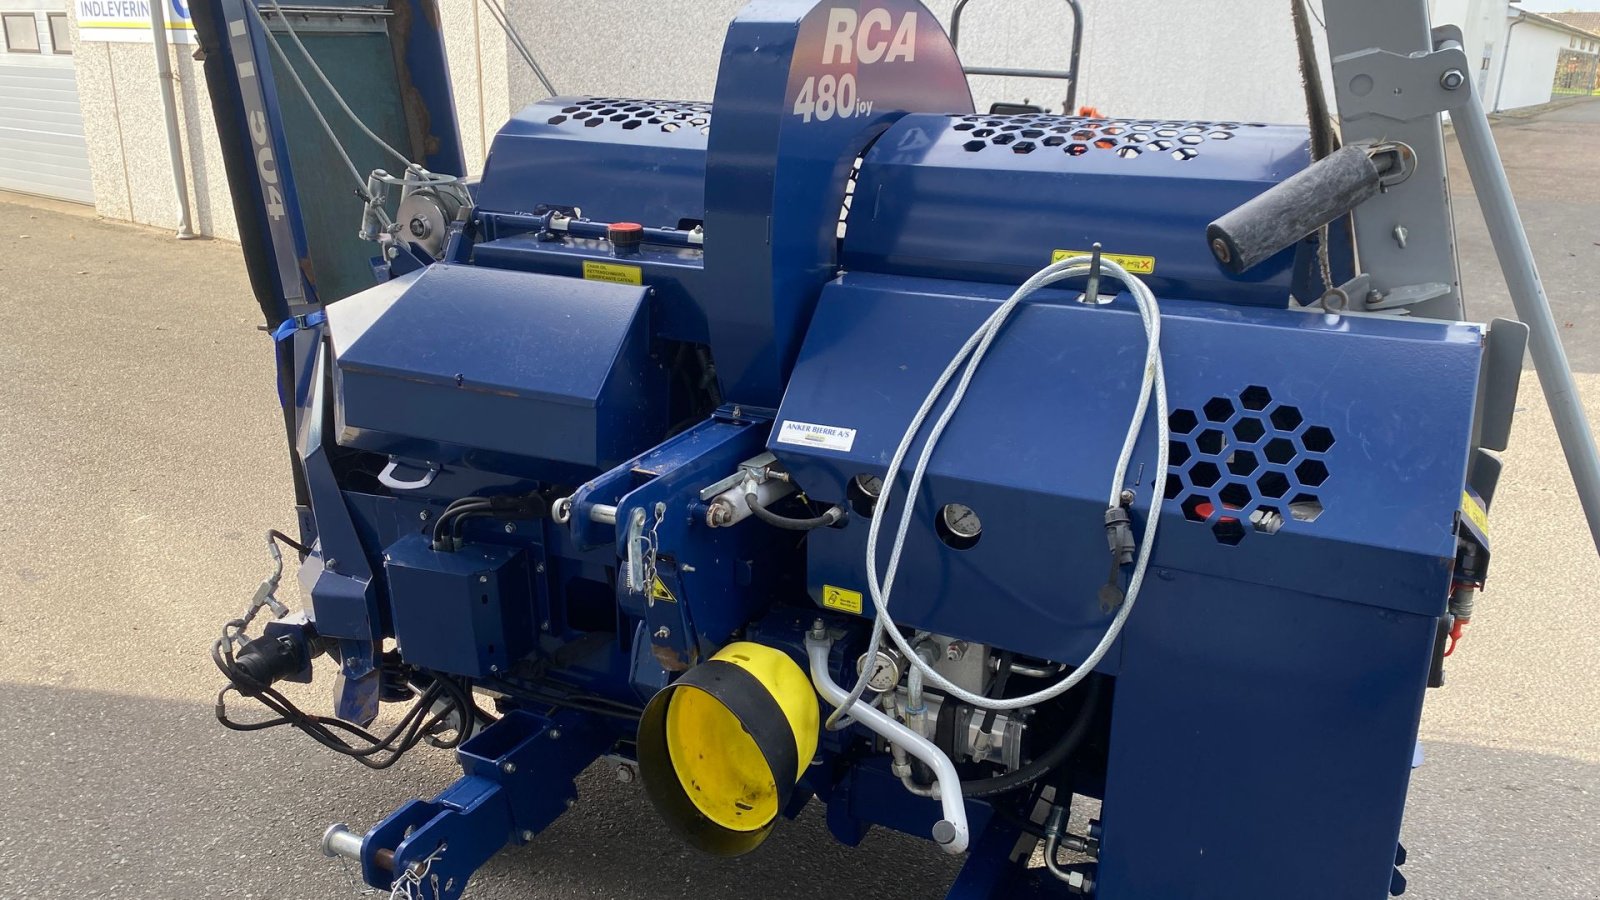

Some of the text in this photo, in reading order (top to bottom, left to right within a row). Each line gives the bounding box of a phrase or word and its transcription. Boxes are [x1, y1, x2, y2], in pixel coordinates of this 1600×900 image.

[821, 7, 918, 64] RCA
[793, 72, 873, 123] 480 joy
[250, 110, 286, 221] 504
[786, 423, 811, 433] ANKER
[812, 426, 836, 436] BJERRE
[837, 429, 850, 438] A/S
